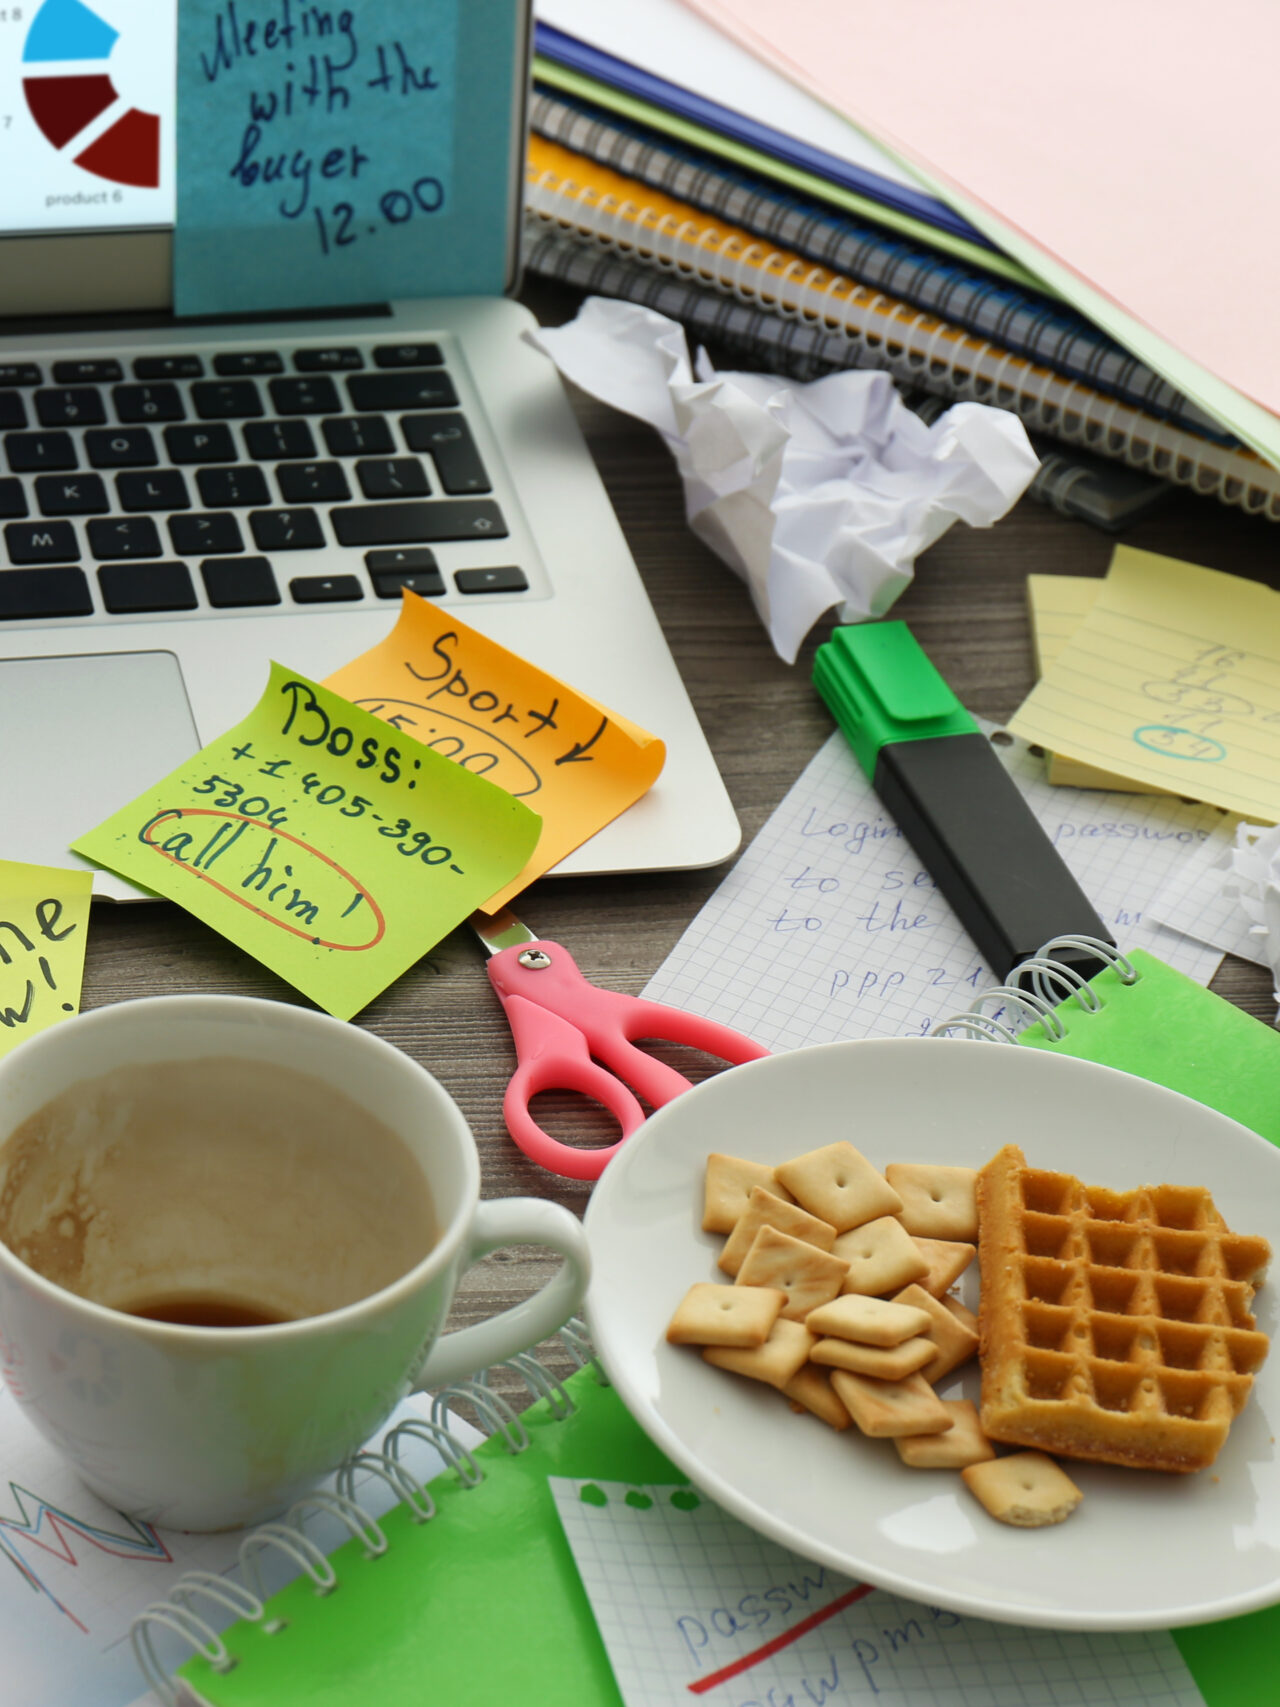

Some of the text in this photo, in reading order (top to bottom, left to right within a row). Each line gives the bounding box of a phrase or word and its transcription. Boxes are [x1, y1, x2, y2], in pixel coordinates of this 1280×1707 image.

[12, 7, 23, 22] 8
[250, 40, 439, 122] with the
[3, 115, 13, 131] 7
[230, 122, 369, 218] buyer
[44, 189, 123, 209] product 6
[314, 176, 444, 254] 12.00
[194, 434, 209, 449] P
[64, 484, 81, 499] K
[147, 481, 160, 496] L
[32, 532, 54, 547] M
[405, 632, 558, 739] Sport
[281, 681, 422, 789] Boss:
[137, 809, 250, 870] Call
[784, 866, 938, 893] to se
[767, 899, 938, 932] to the
[829, 969, 905, 998] ppp
